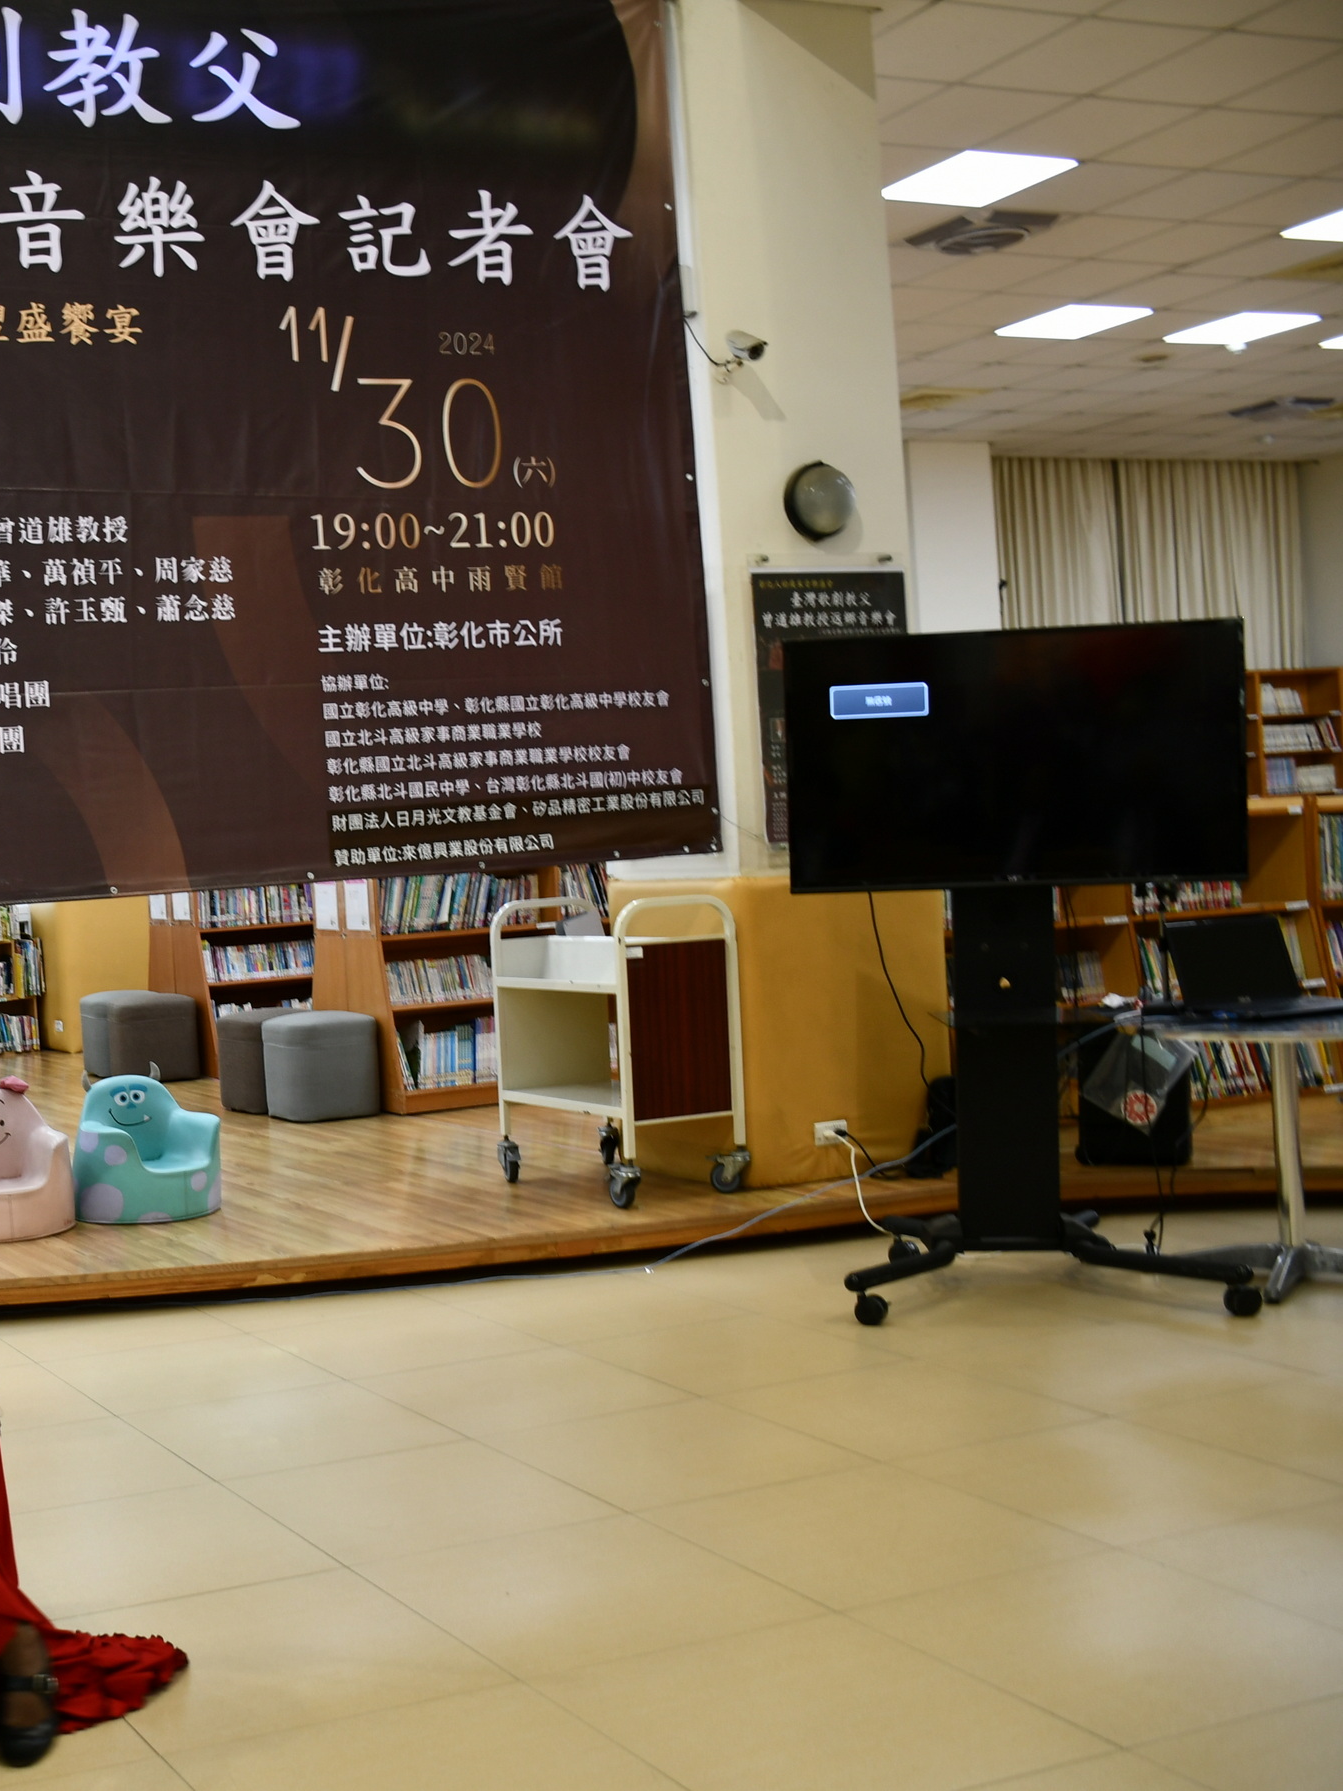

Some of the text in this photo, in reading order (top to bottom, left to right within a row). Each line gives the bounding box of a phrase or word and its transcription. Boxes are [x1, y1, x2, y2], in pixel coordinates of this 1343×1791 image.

[278, 305, 354, 393] 11/
[438, 331, 496, 356] 2024
[356, 377, 557, 490] 30 (六)
[310, 511, 556, 551] 19:00~21:00
[318, 564, 564, 595] 彰化高中雨賢館
[318, 618, 564, 654] 主辦單位:彰化市公所
[320, 673, 390, 693] 協辦單位:
[322, 689, 670, 721] 國立彰化高級中學、彰化縣國立彰化高級中學校友會
[324, 721, 543, 748] 國立北斗高級家事商業職業學校
[326, 743, 631, 776] 彰化縣國立北斗高級家事商業職業學校校友會
